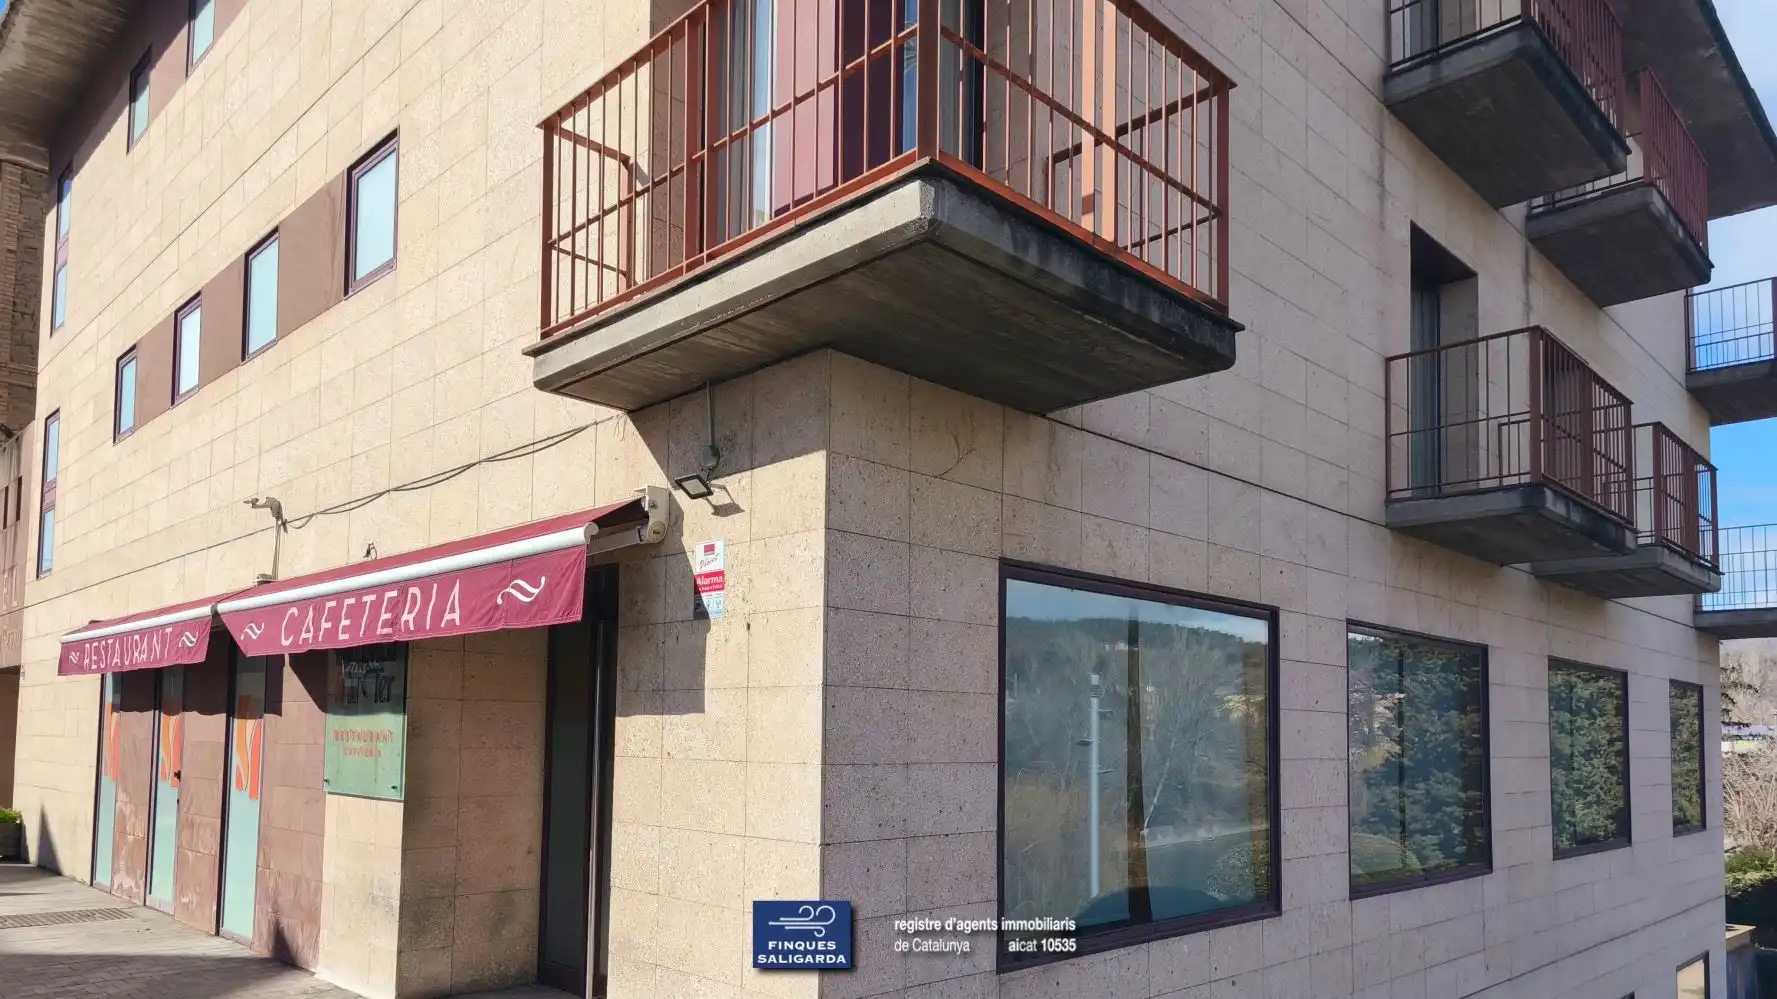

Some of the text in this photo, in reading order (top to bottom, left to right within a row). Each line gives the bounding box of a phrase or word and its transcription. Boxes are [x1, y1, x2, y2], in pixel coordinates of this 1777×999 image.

[696, 575, 723, 586] Alarma
[280, 578, 461, 646] CAFETERIA
[83, 627, 173, 671] RESTAURANT
